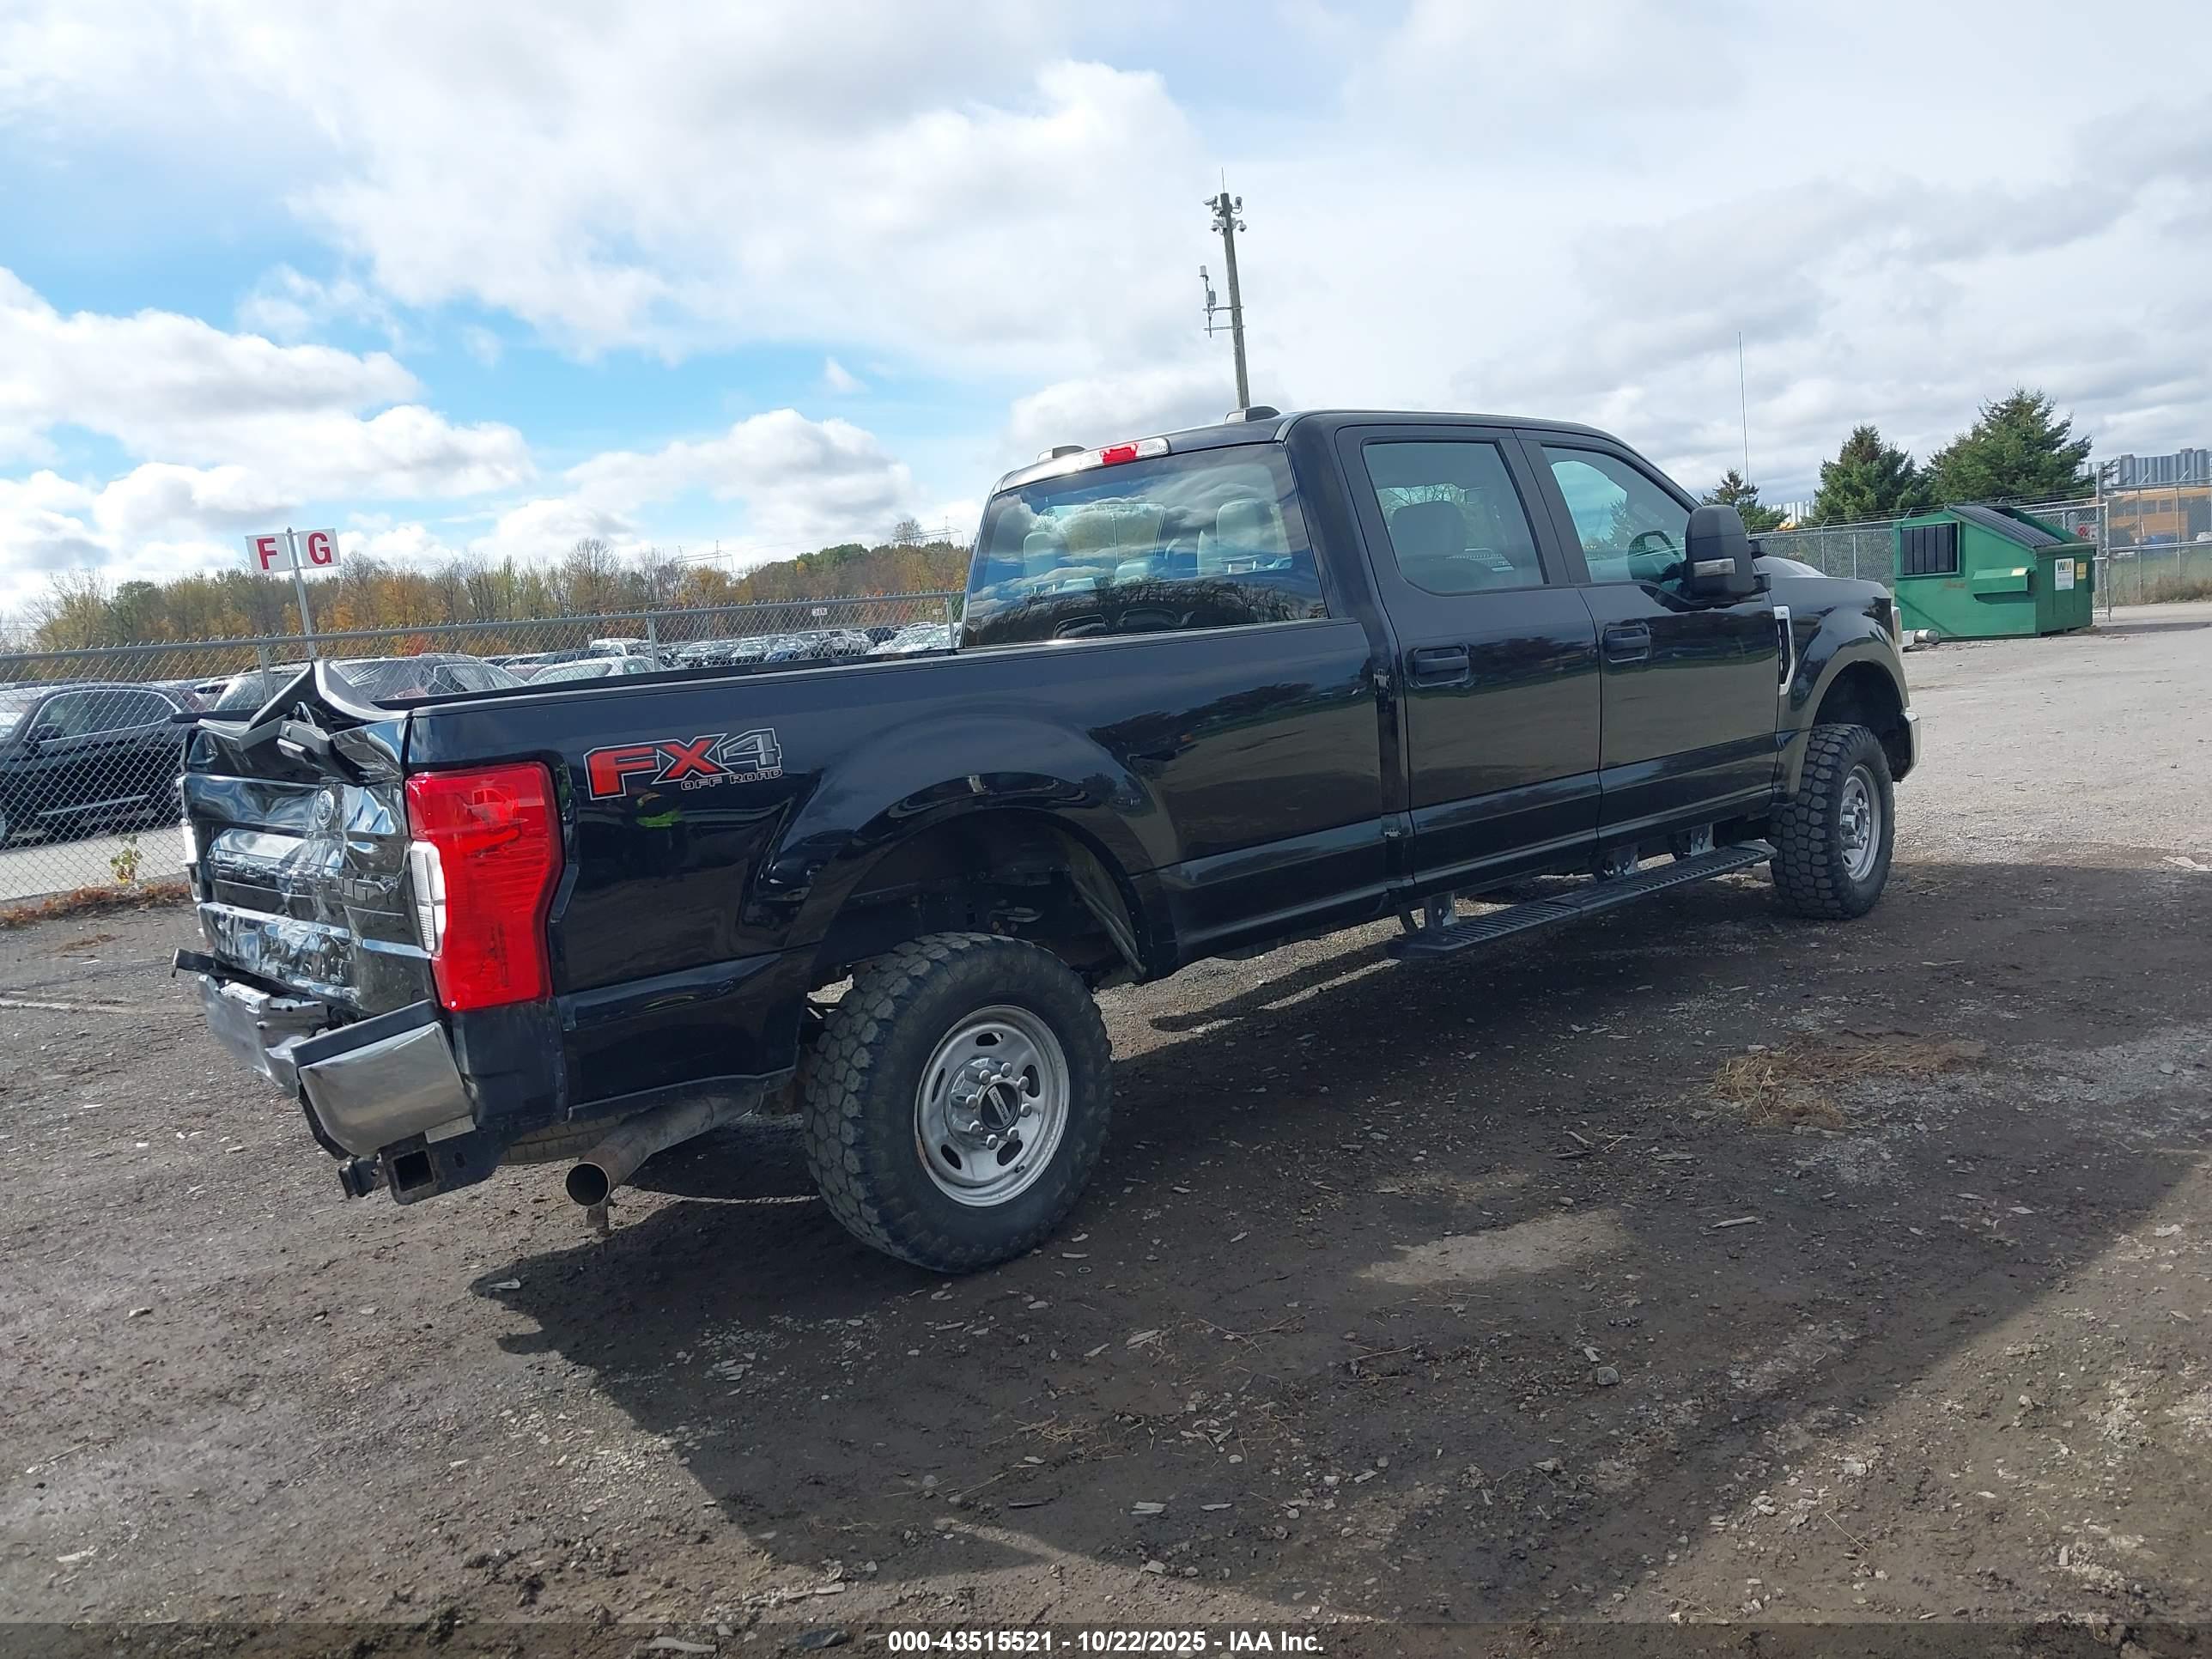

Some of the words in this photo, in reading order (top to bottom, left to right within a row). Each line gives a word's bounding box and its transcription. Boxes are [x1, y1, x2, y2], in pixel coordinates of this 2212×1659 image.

[257, 538, 277, 569] F
[307, 532, 332, 565] G
[583, 728, 782, 800] FX4
[681, 776, 723, 790] OFF
[729, 769, 783, 784] ROAD
